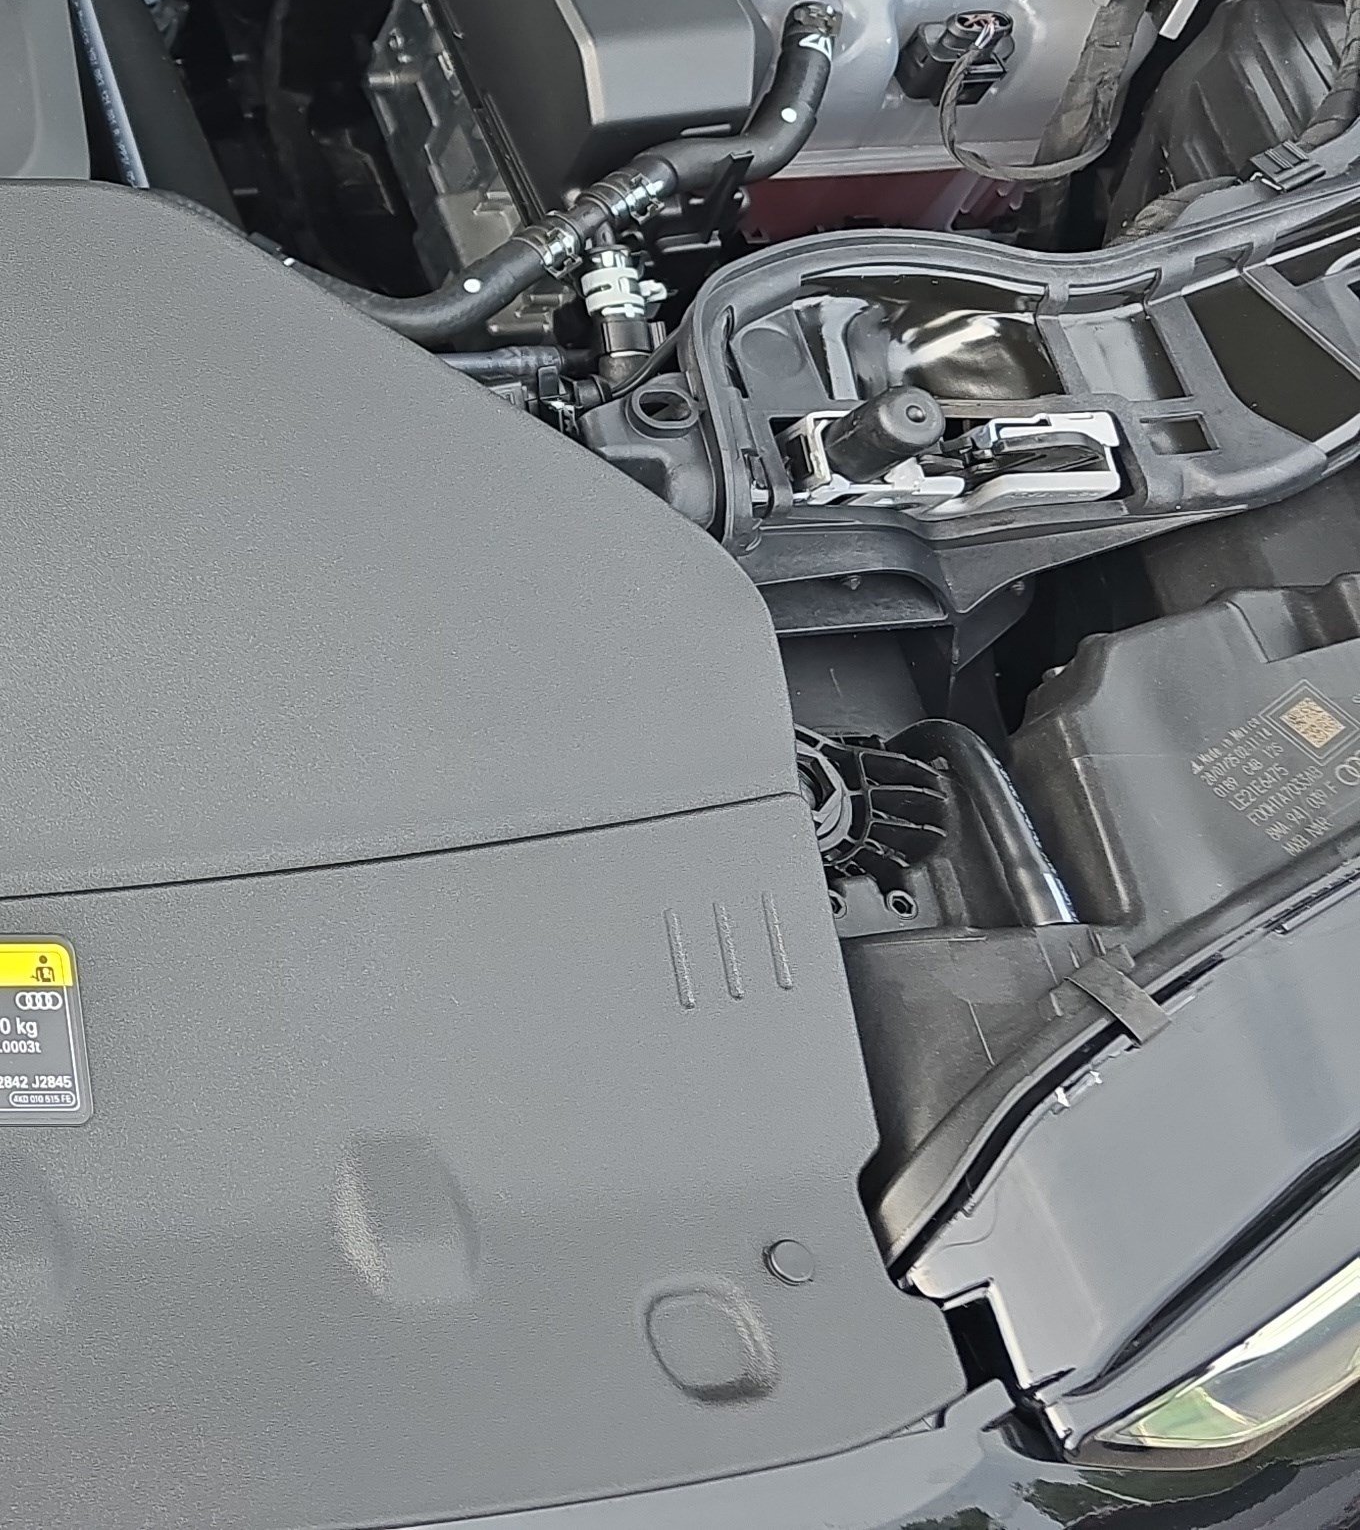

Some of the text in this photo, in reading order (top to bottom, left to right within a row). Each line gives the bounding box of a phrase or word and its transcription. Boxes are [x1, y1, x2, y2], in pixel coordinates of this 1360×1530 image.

[15, 1017, 37, 1038] kg
[31, 1075, 72, 1088] J2845
[60, 1094, 72, 1103] FE
